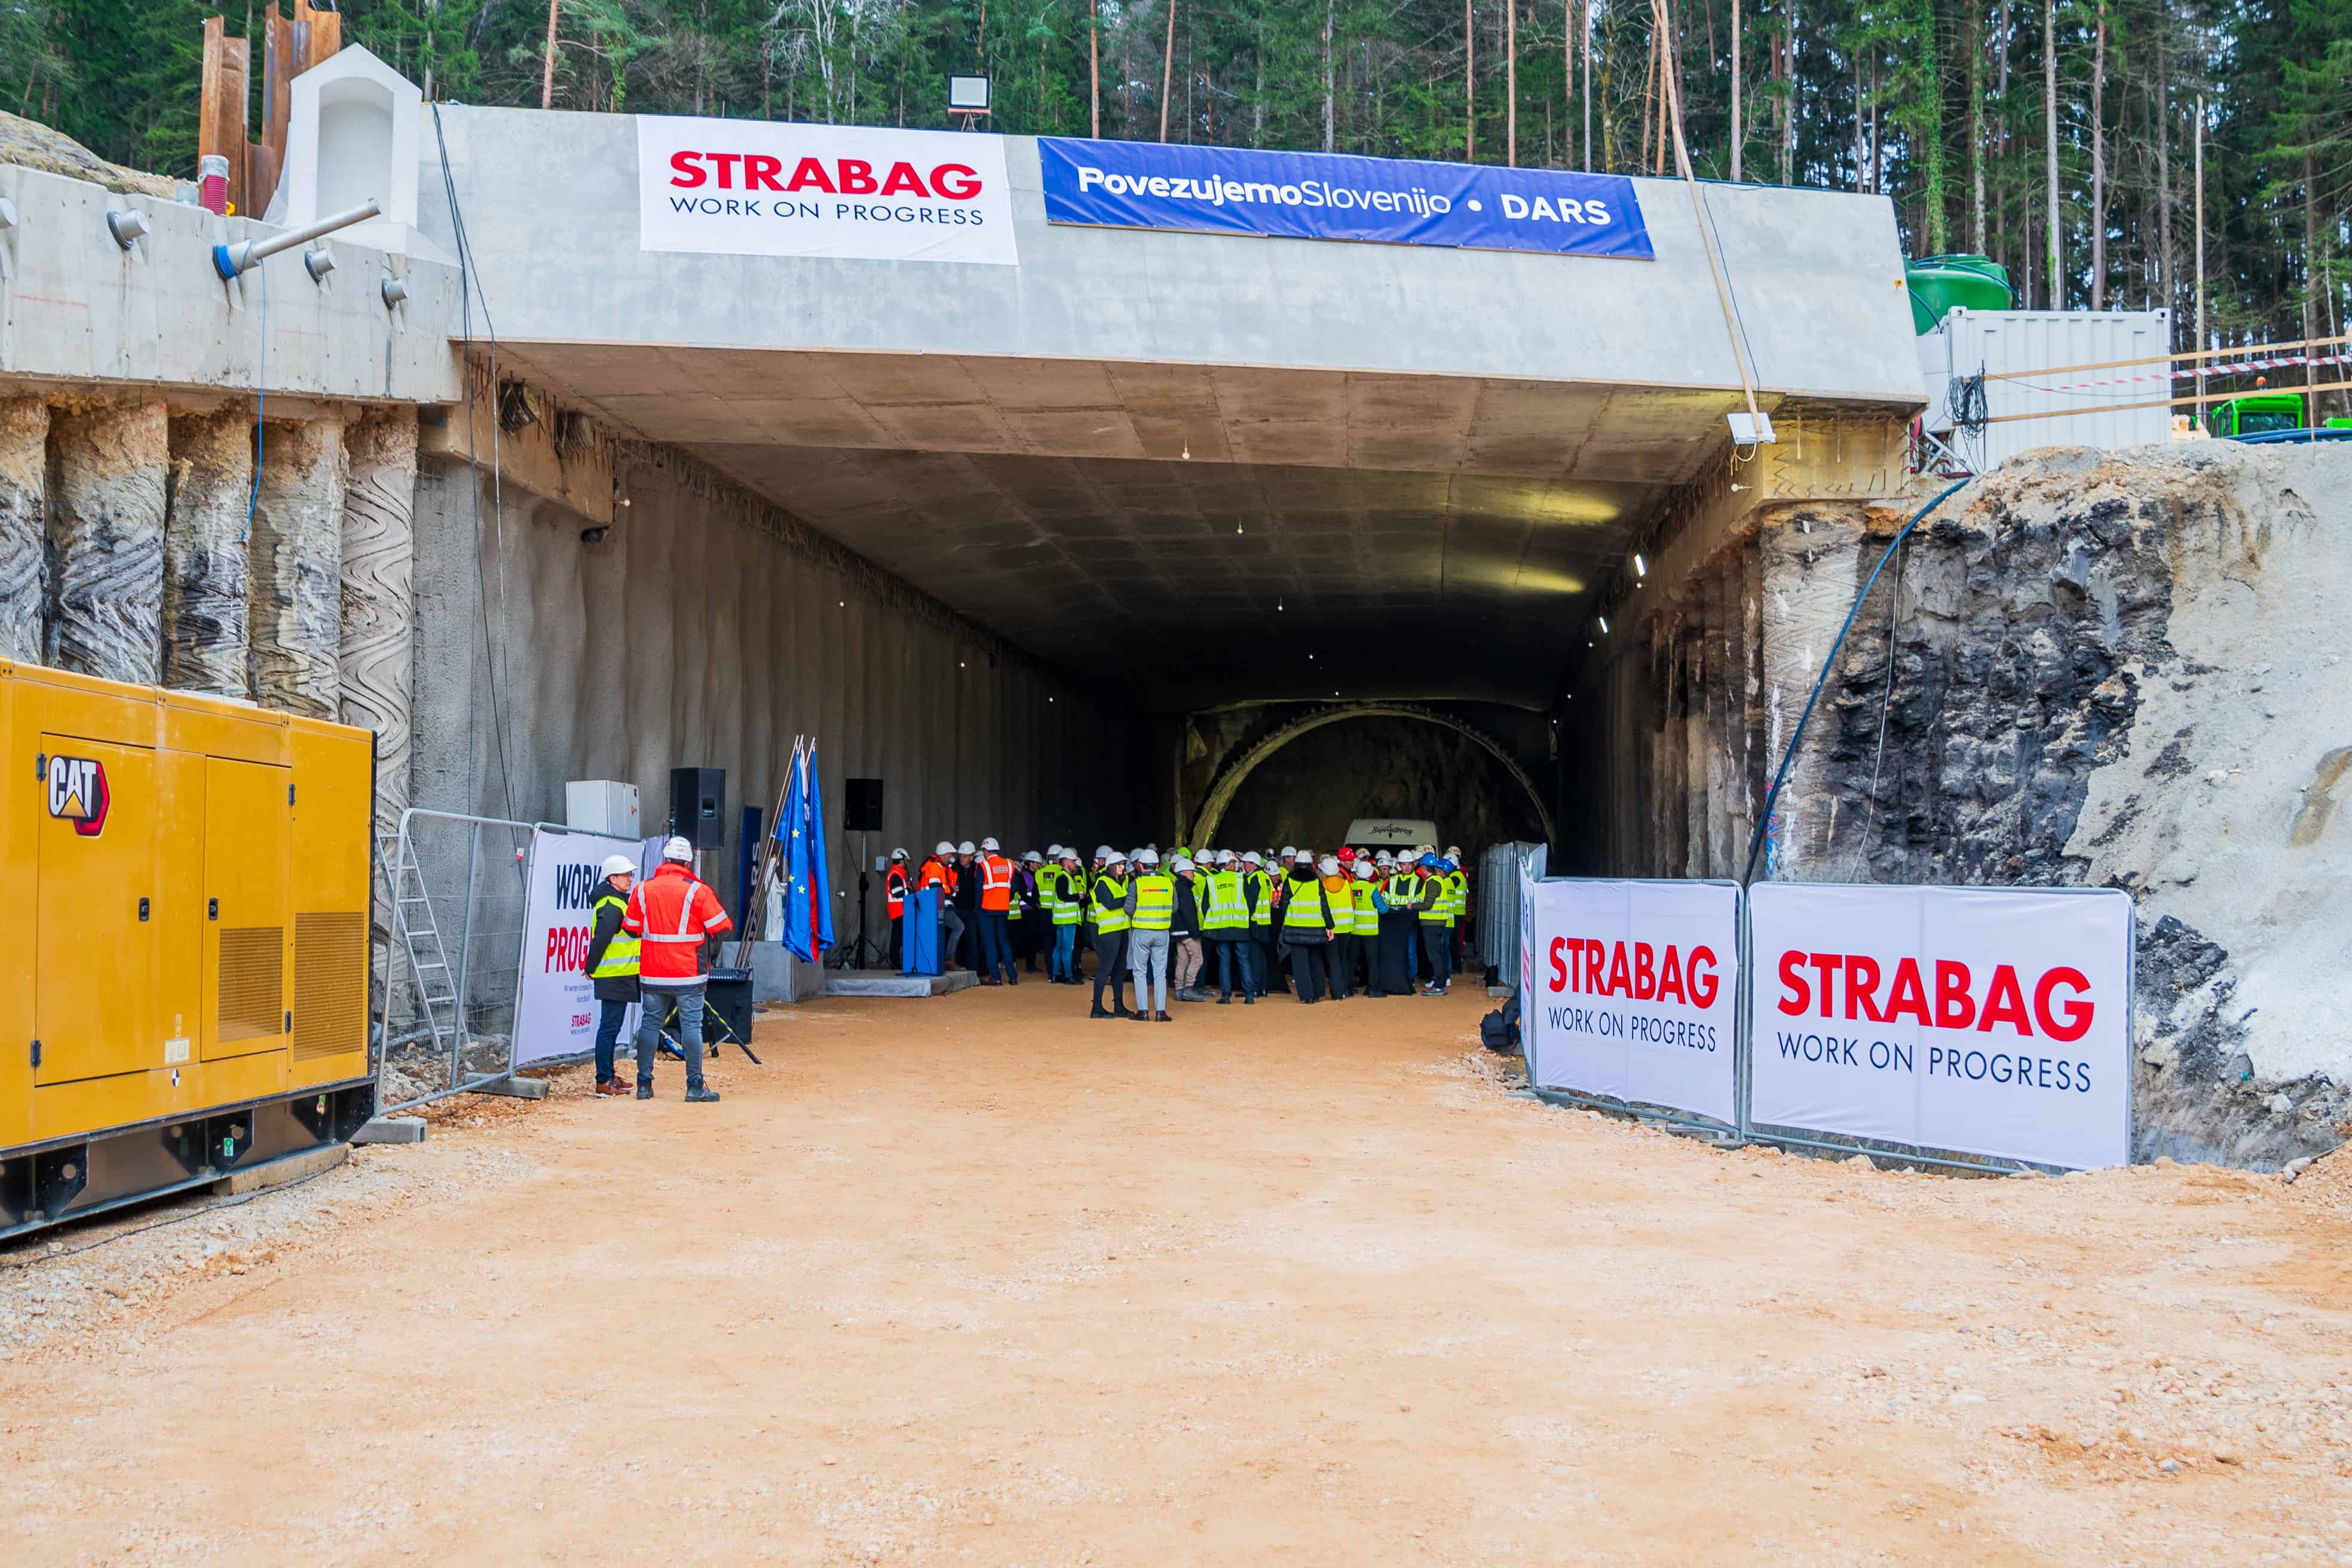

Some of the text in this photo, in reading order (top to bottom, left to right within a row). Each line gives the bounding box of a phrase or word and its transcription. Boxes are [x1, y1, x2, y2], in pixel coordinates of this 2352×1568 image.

[670, 151, 982, 200] STRABAG
[1077, 166, 1611, 225] PovezujemoSlovenijo DARS
[669, 197, 983, 225] WORK ON PROGRESS
[50, 757, 97, 817] CAT
[1548, 936, 1719, 1009] STRABAG
[1778, 950, 2094, 1042] STRABAG
[1548, 1006, 1594, 1034] WORK
[1598, 1012, 1623, 1038] ON
[1631, 1015, 1716, 1052] PROGRESS
[1777, 1031, 2091, 1093] WORK ON PROGRESS
